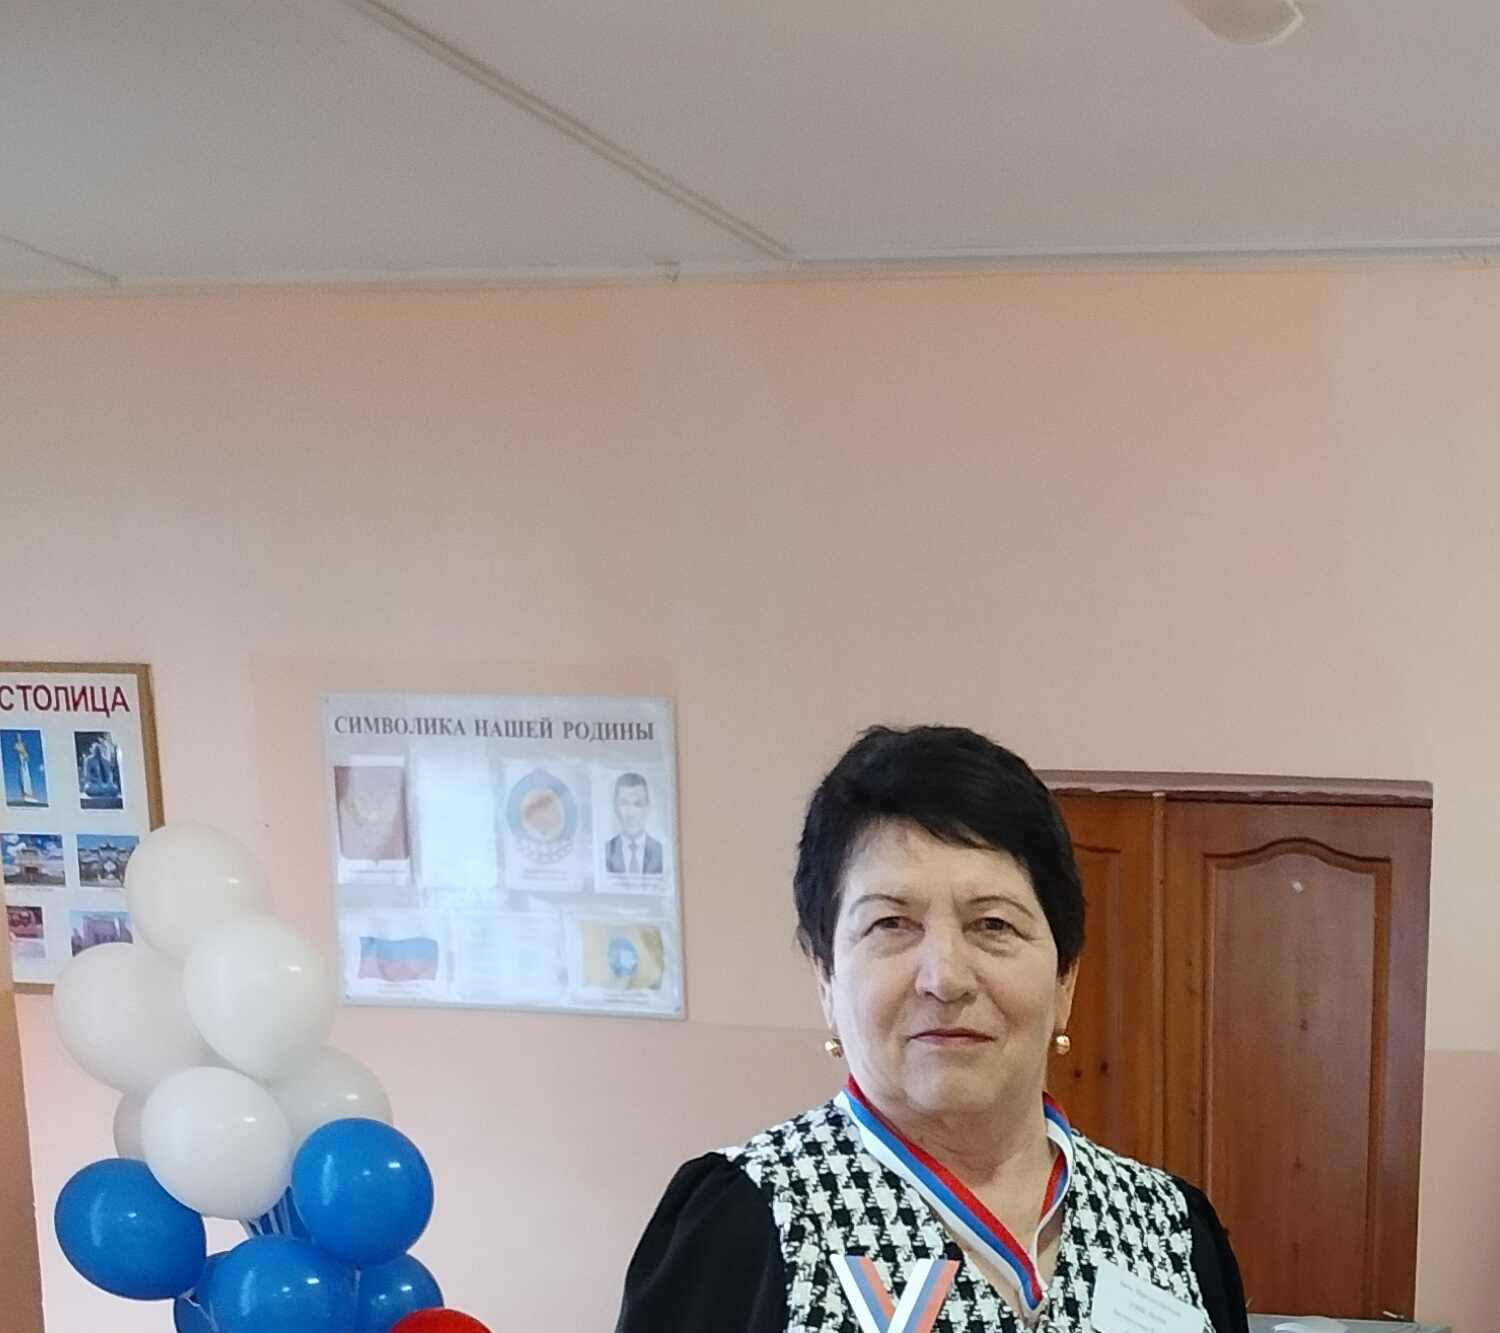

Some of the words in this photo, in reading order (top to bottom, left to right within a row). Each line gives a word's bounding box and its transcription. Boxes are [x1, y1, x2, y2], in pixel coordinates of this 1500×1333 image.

[0, 684, 130, 718] СТОЛИЦА
[334, 715, 466, 737] СИМВОЛИКА
[475, 717, 553, 739] НАШЕЙ
[562, 721, 655, 742] РОДИНЫ
